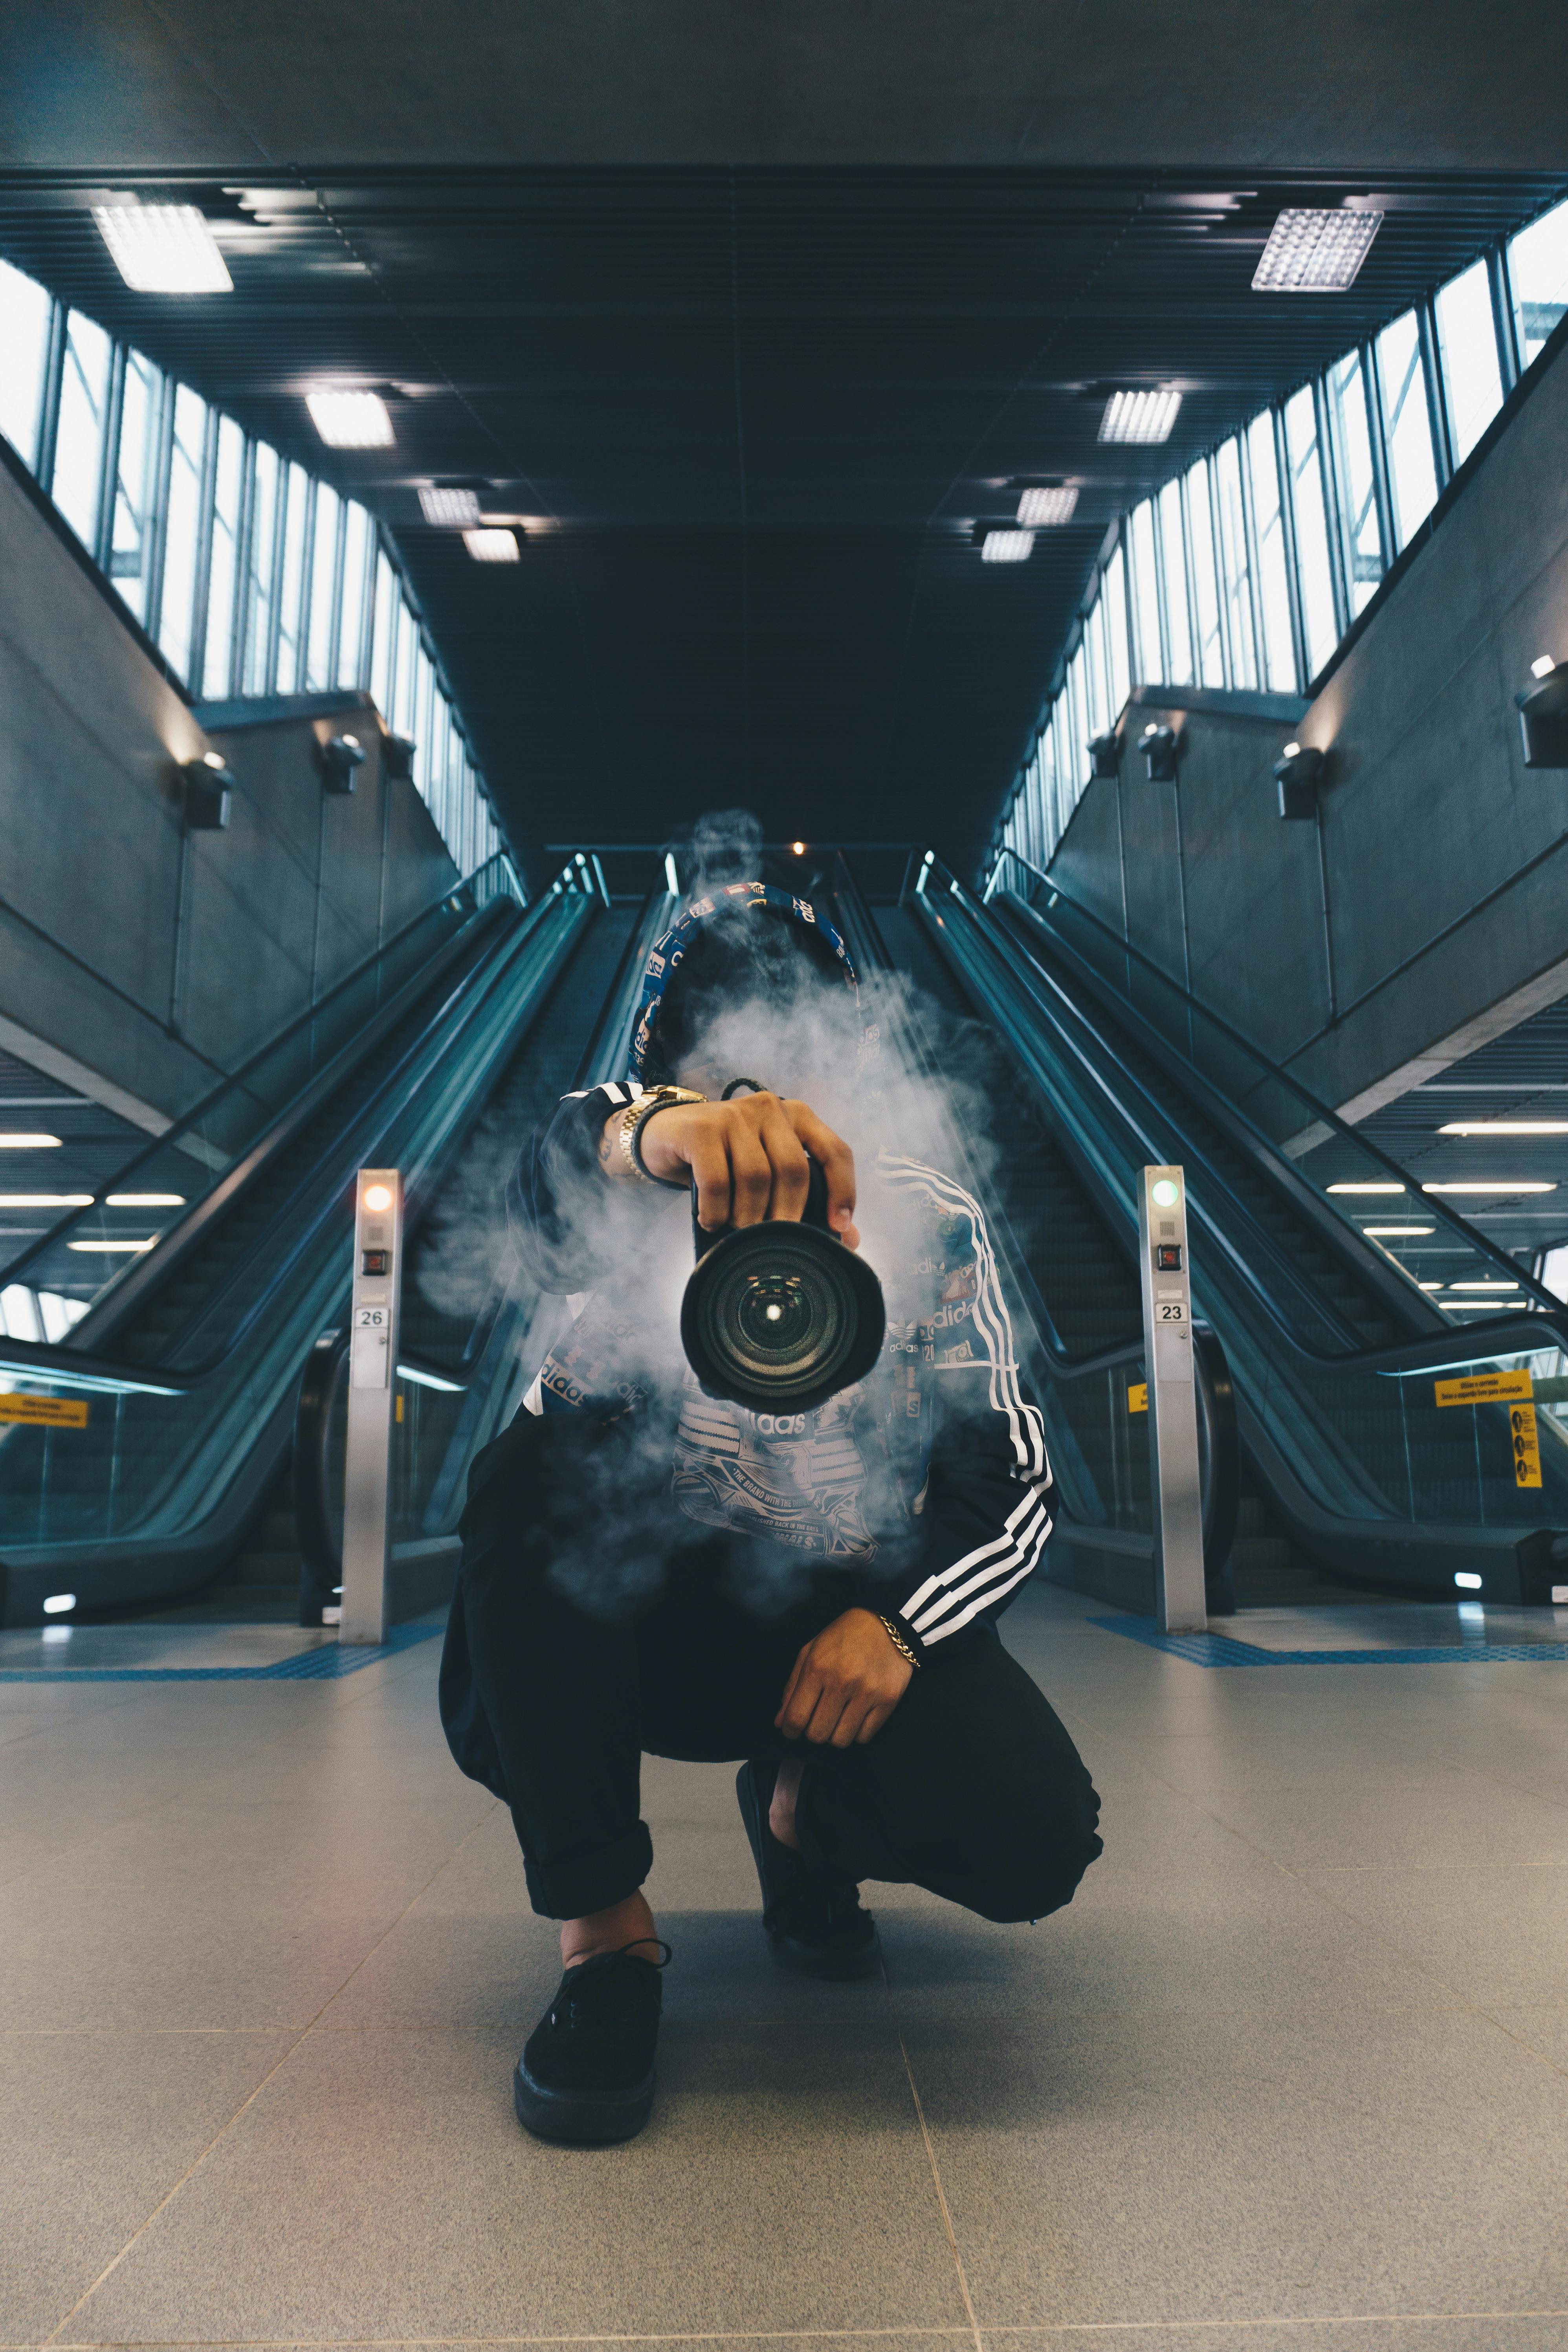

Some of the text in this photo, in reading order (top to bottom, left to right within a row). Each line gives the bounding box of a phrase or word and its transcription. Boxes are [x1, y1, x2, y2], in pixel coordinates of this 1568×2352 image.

[361, 1311, 382, 1325] 26
[1162, 1306, 1181, 1319] 23
[733, 1469, 746, 1482] THE
[743, 1480, 765, 1499] BRAND
[765, 1494, 780, 1506] WITH
[781, 1499, 792, 1507] THE
